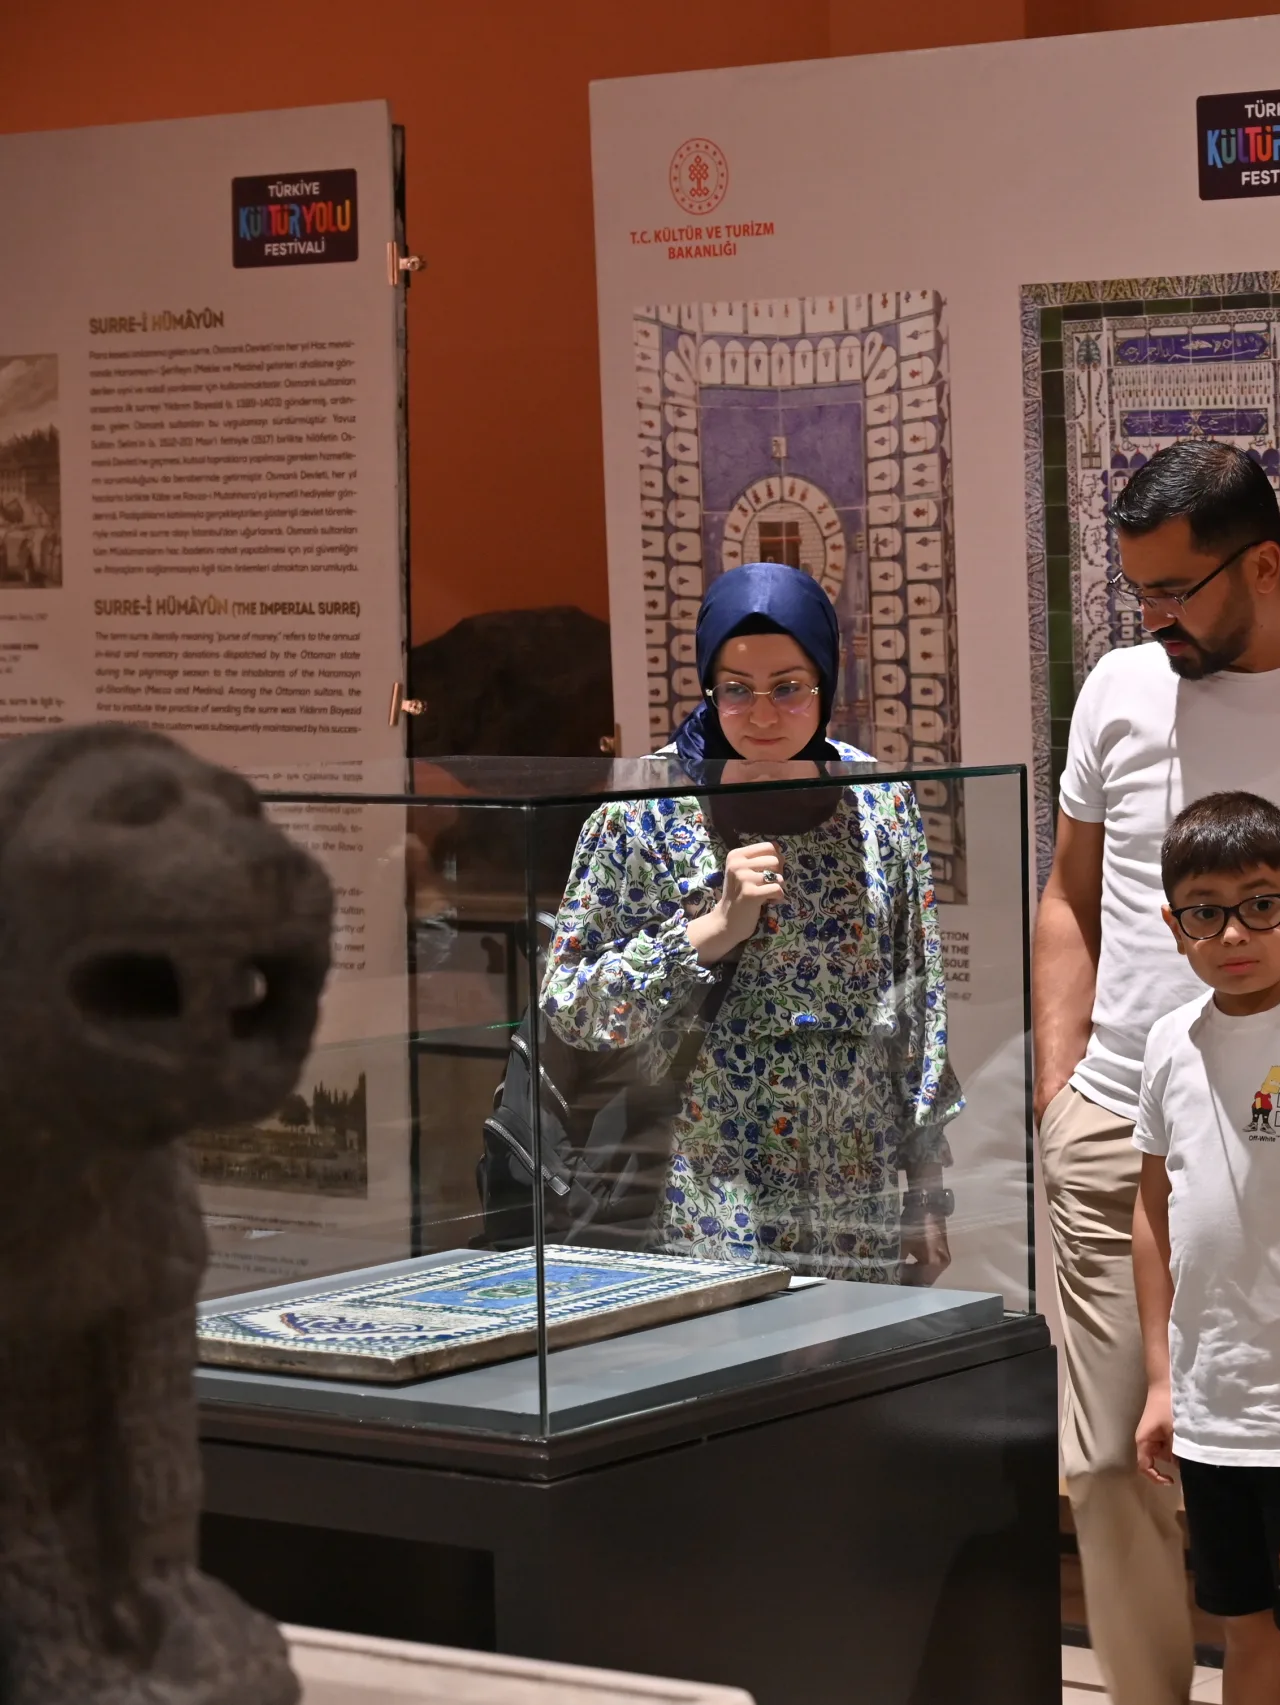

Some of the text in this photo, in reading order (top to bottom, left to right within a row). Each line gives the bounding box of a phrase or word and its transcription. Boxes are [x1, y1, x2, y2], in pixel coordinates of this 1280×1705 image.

[268, 180, 320, 197] TÜRKİYE
[630, 220, 775, 244] T.C. KÜLTÜR VE TURİZM
[264, 237, 325, 256] FESTİVALİ
[668, 241, 737, 260] BAKANLIĞI
[94, 595, 152, 616] SURRE-İ
[232, 602, 257, 619] (THE
[259, 602, 315, 615] IMPERIAL
[318, 601, 360, 618] SURRE)
[283, 632, 305, 641] refers
[332, 633, 360, 641] annual
[301, 650, 336, 659] Ottoman
[340, 651, 360, 659] state
[229, 687, 256, 698] Among
[276, 686, 310, 696] Ottoman
[951, 944, 969, 955] THE
